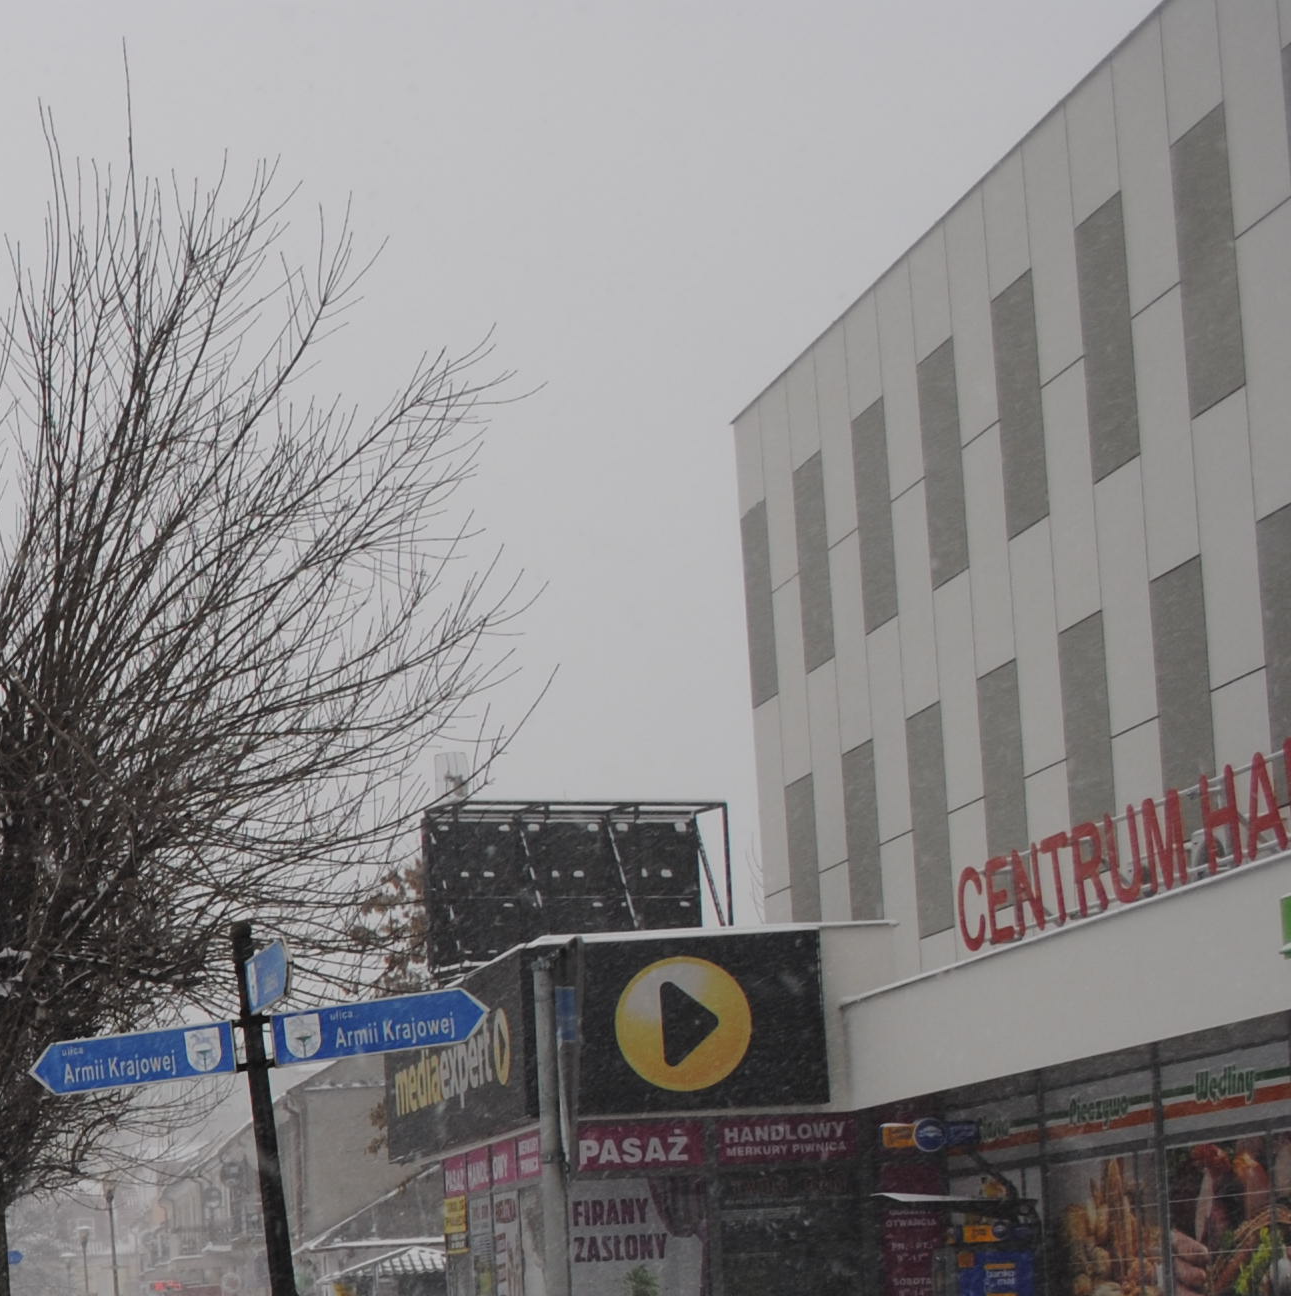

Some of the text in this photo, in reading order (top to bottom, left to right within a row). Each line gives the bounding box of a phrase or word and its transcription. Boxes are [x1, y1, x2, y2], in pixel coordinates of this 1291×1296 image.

[958, 737, 1291, 952] CENTRUM HA
[330, 1011, 354, 1022] ulica
[336, 1012, 456, 1049] Armii Krajowej
[61, 1047, 85, 1057] ulica
[63, 1050, 177, 1085] Armii Krajowej
[1195, 1065, 1255, 1102] Wędliny
[579, 1129, 689, 1165] PASAŻ
[724, 1121, 846, 1144] HANDLOWY
[726, 1141, 847, 1157] MERKURY PIWNICA
[572, 1198, 649, 1227] FIRANY
[573, 1232, 668, 1263] ZASŁONY
